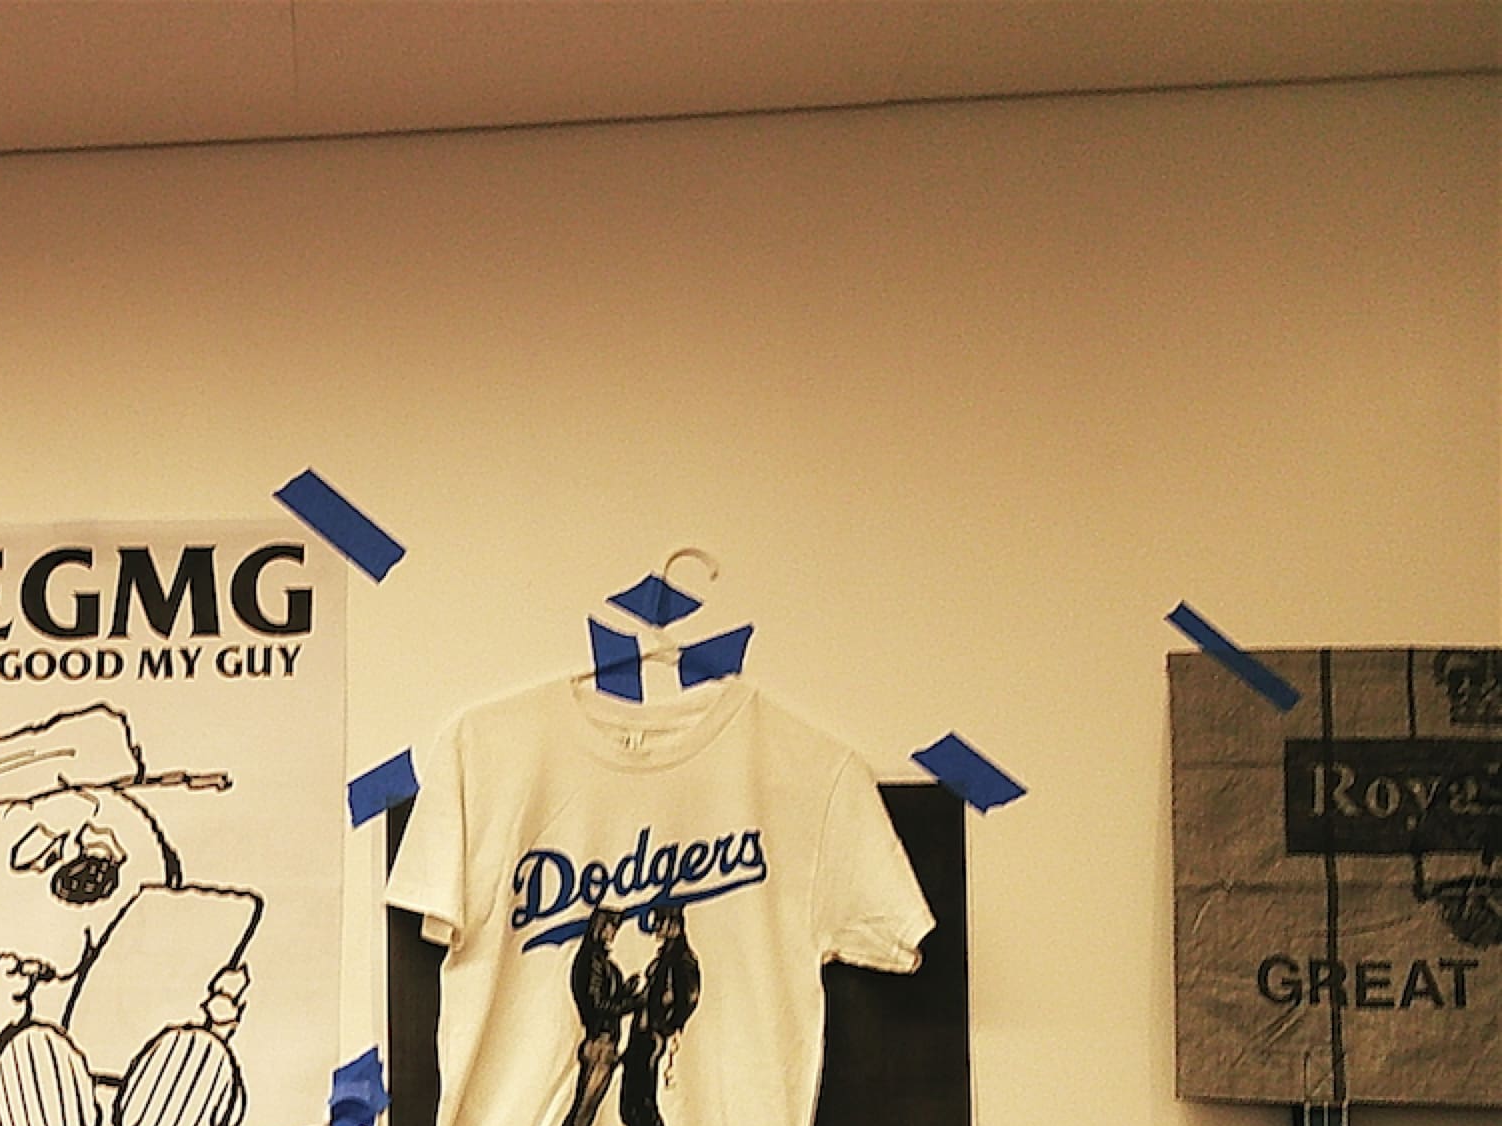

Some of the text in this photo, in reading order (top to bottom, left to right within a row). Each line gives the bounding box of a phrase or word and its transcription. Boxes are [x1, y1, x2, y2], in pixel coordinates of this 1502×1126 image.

[138, 647, 200, 679] MY
[215, 645, 302, 678] GUY
[511, 826, 767, 950] Dodgers
[1257, 953, 1478, 1009] GREAT
